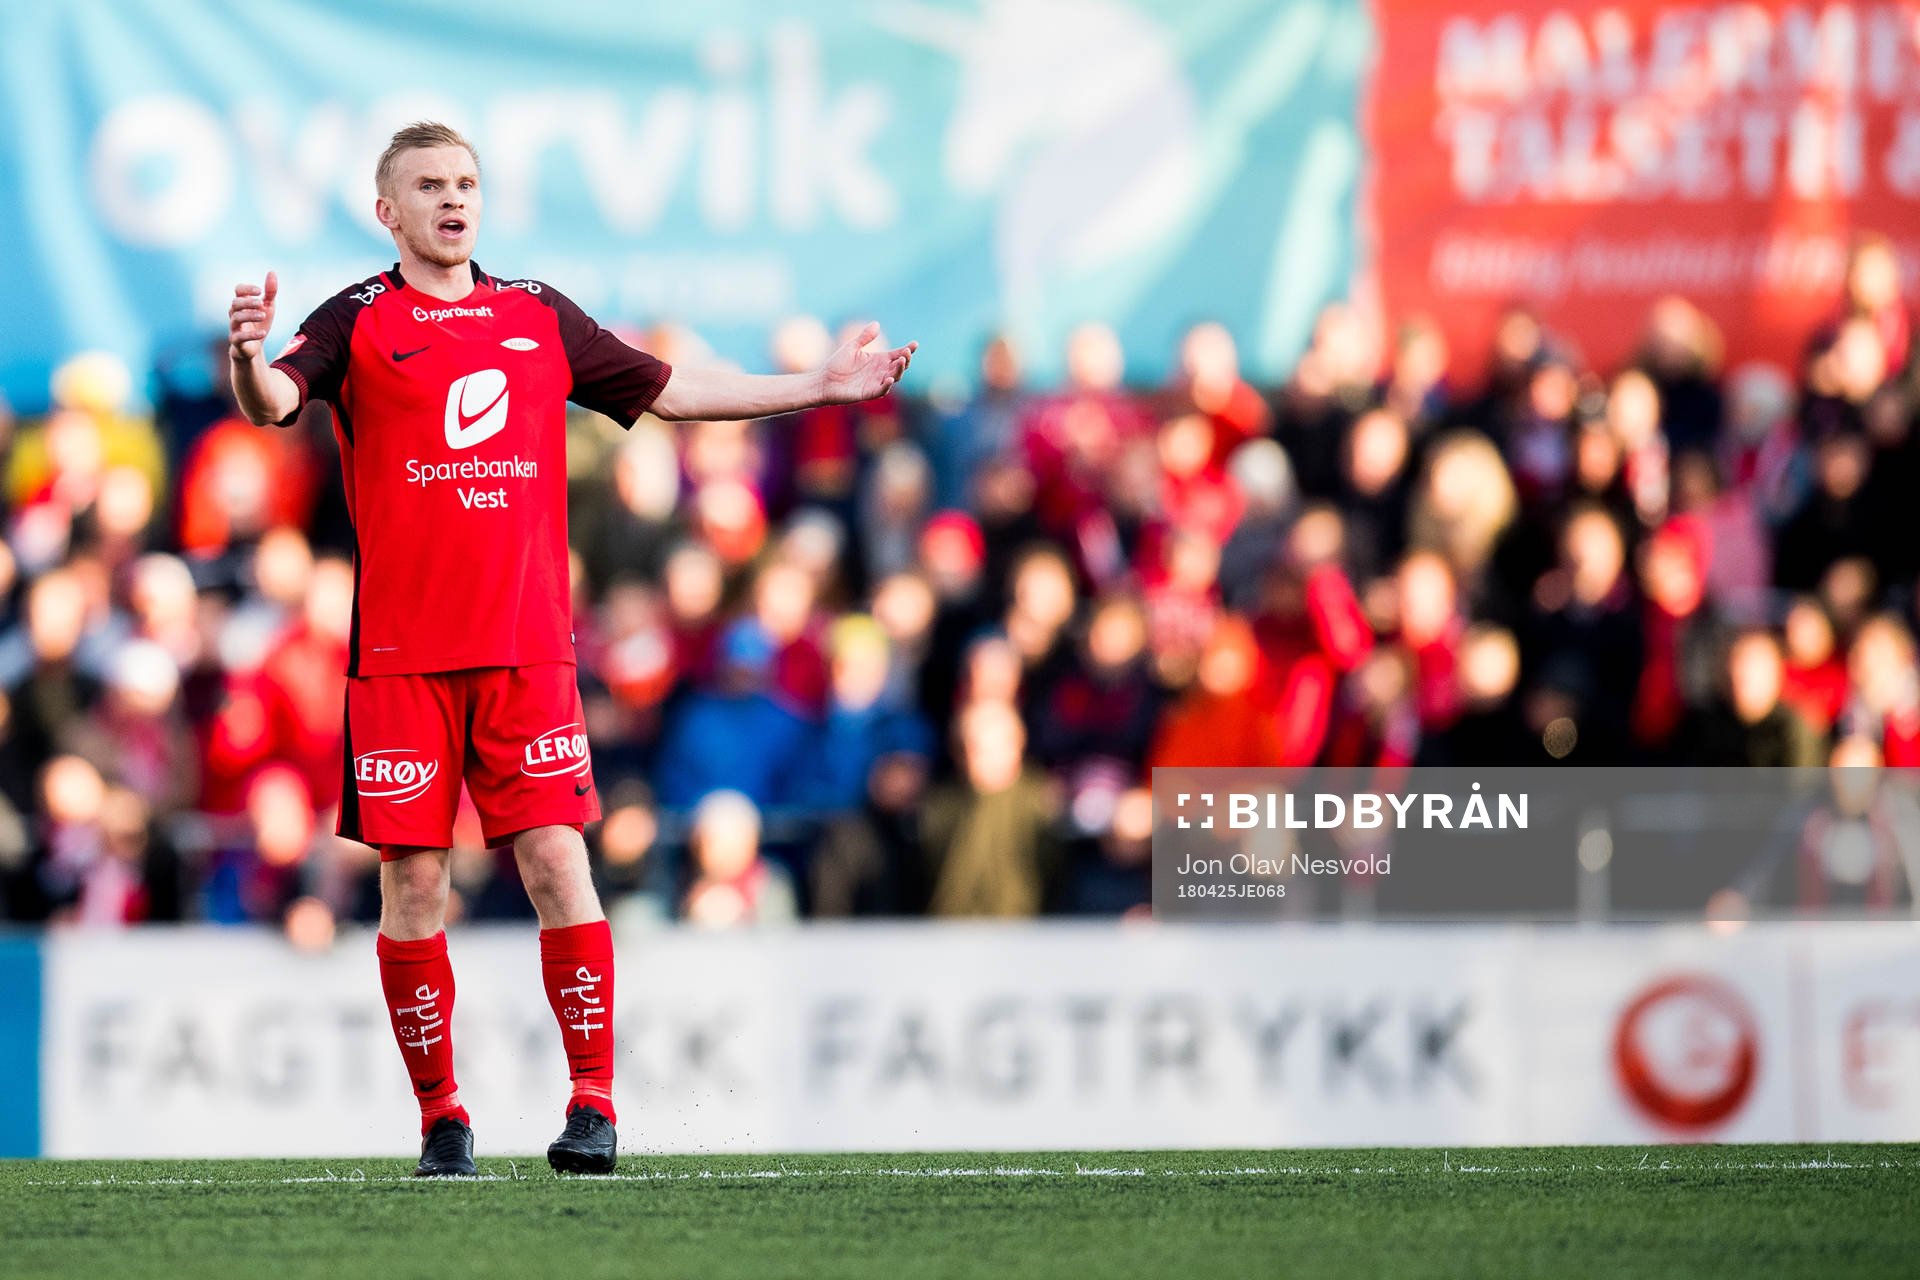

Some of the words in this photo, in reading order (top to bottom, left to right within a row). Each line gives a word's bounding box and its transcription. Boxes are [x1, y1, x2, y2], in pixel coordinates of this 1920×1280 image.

[92, 18, 897, 248] ovrvik
[429, 305, 494, 322] Fjordkraft
[405, 454, 538, 488] Sparebanken
[456, 487, 509, 510] Vest
[396, 983, 444, 1056] tide
[559, 965, 606, 1041] tide
[802, 995, 1489, 1103] FAGTRYKK
